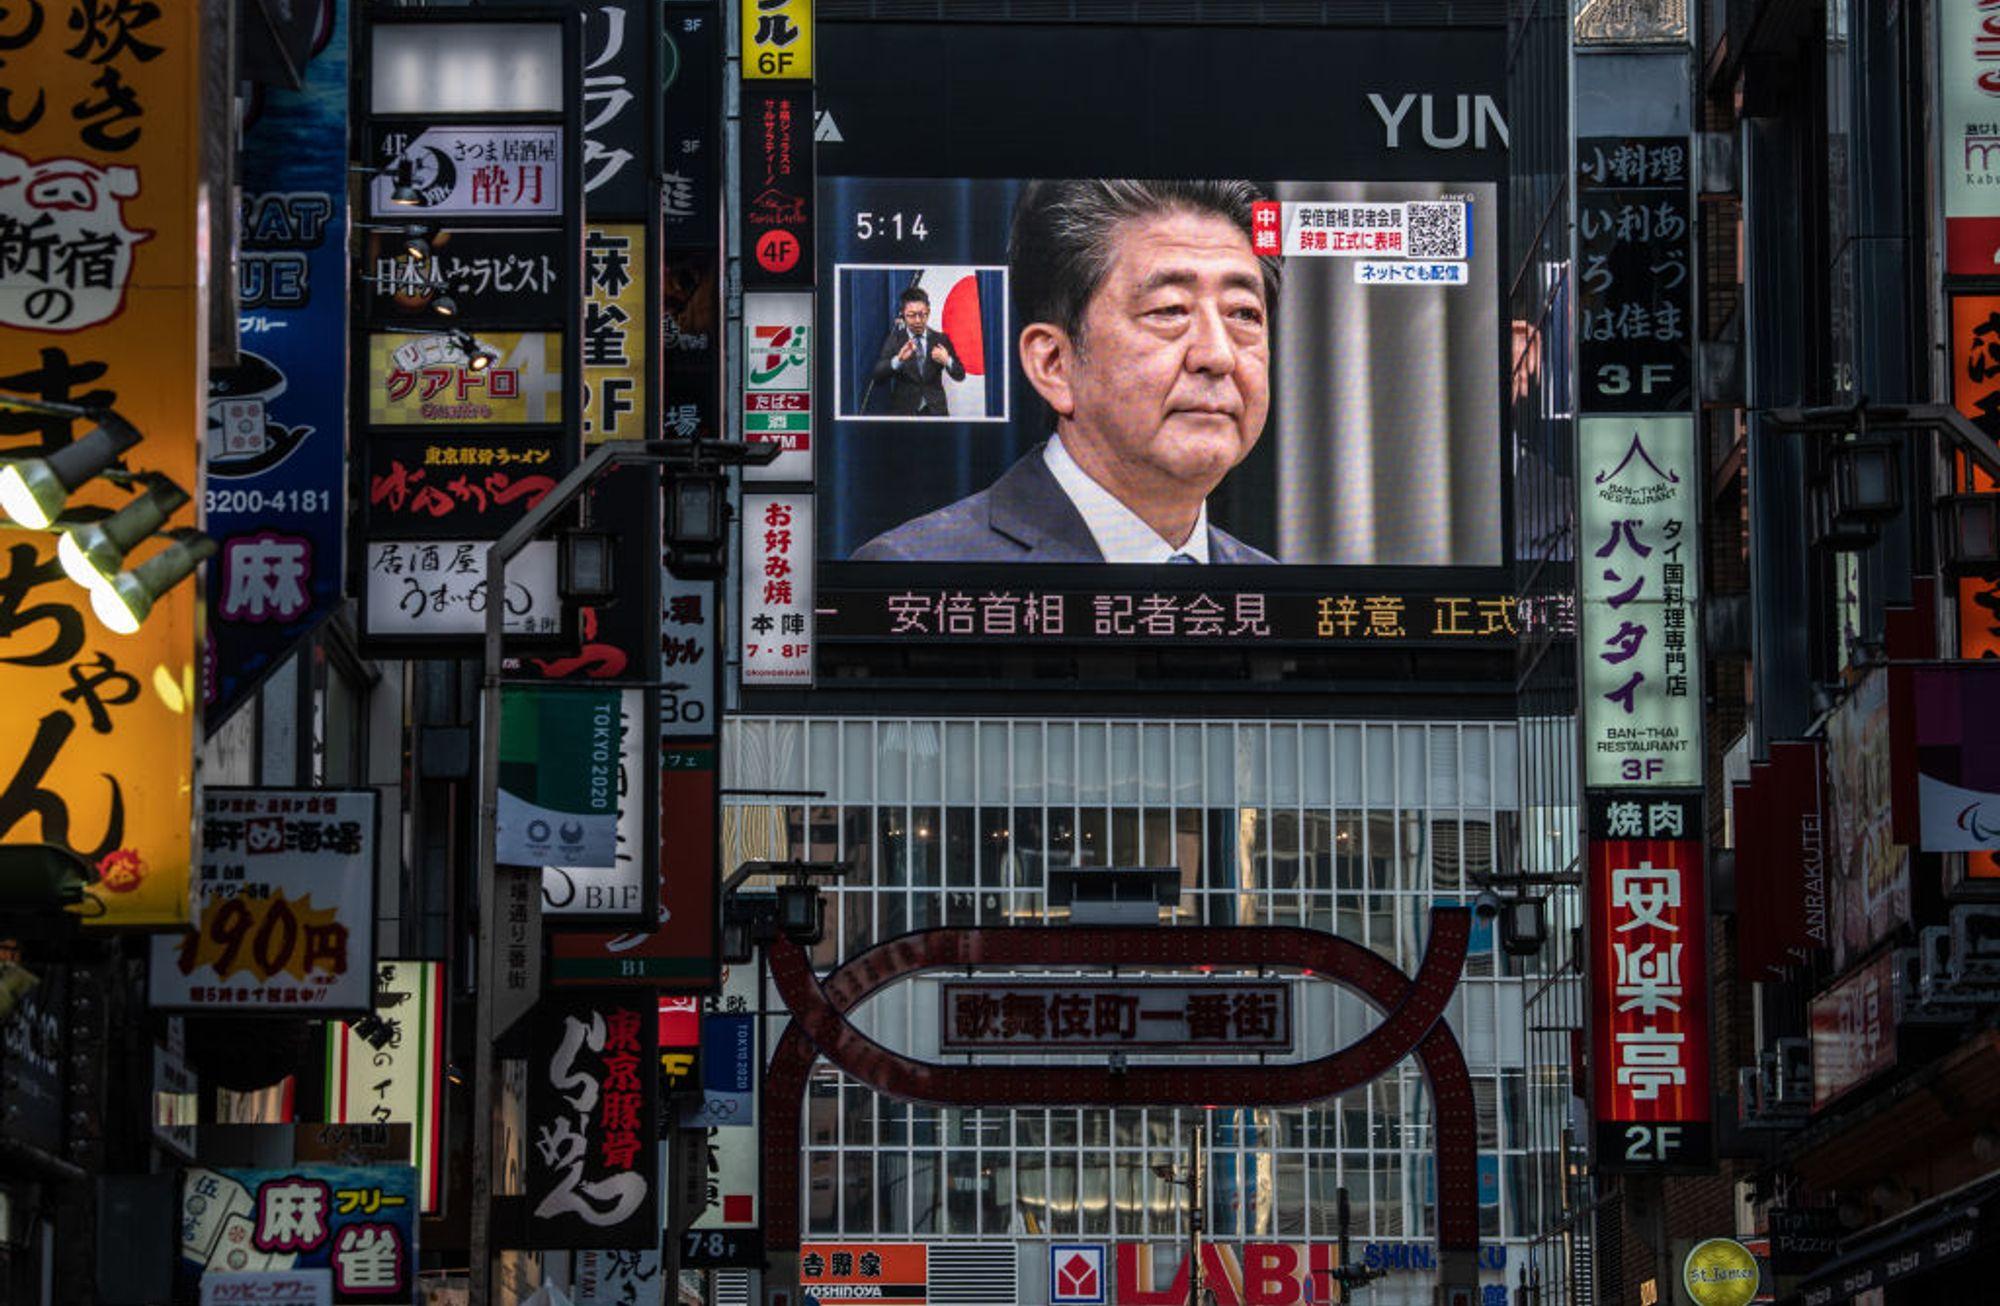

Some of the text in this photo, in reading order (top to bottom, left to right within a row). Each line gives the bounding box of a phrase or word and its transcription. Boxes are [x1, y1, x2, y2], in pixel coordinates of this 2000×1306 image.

[683, 19, 702, 32] 3F
[757, 52, 794, 75] 6F
[1366, 93, 1510, 150] YUN
[682, 140, 701, 153] 3F
[1581, 143, 1685, 184] 小料理
[471, 164, 544, 206] 酔月
[857, 212, 929, 241] 5:14
[1256, 207, 1277, 249] 中継
[1299, 208, 1402, 228] 安倍首相 記者会見
[0, 211, 123, 291] 新宿
[764, 240, 792, 263] 4F
[1300, 231, 1402, 250] 辞意 正式に表明
[376, 254, 557, 297] 日本人セラピスト
[1361, 264, 1461, 282] ネットでも配信
[1581, 206, 1614, 342] いろは
[1650, 202, 1686, 341] あづま
[387, 368, 518, 401] クアトロ
[1597, 363, 1674, 394] 3F
[755, 395, 801, 410] たばこ
[372, 543, 480, 575] 居酒屋
[763, 502, 793, 606] お好み焼
[226, 539, 307, 616] 麻
[751, 613, 805, 637] 本陣
[888, 591, 1065, 635] 安倍首相
[1092, 593, 1271, 636] 記者会見
[1317, 595, 1406, 637] 辞意
[1432, 595, 1518, 635] 正式
[1595, 519, 1653, 714] バンタイ
[1662, 518, 1687, 698] タイ国料理専門店
[1597, 740, 1689, 753] RESTAURANT
[1606, 726, 1679, 739] BAN-THAI
[592, 705, 611, 809] TOKYO 2020
[660, 754, 698, 767] フェ
[1621, 758, 1664, 781] 3F
[1606, 802, 1684, 837] 焼肉
[584, 884, 640, 911] B1F
[508, 868, 530, 990] 場通り一番街
[621, 958, 646, 979] B1
[1611, 860, 1686, 1101] 安楽亭
[954, 992, 1278, 1042] 歌舞伎町一番街
[736, 1024, 750, 1090] TOKYO 2020
[601, 1008, 642, 1171] 東京豚骨
[1624, 1125, 1683, 1162] 2F
[335, 1188, 405, 1215] フリー
[802, 1252, 881, 1278] 吉野家
[1115, 1243, 1335, 1306] LABI
